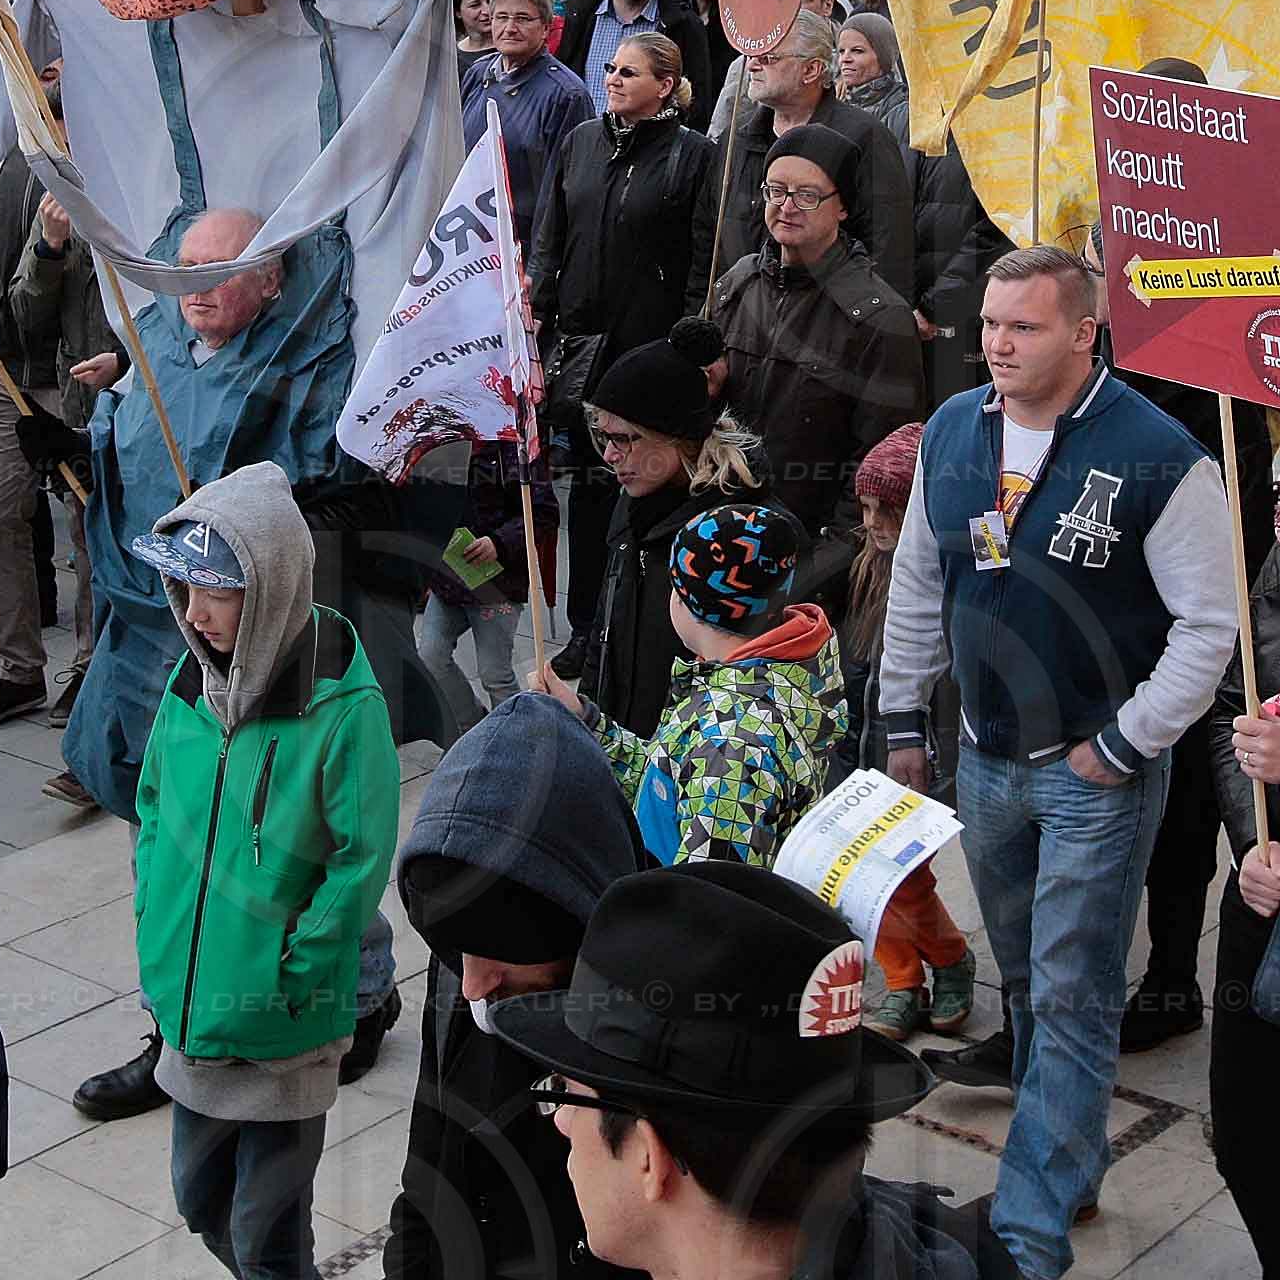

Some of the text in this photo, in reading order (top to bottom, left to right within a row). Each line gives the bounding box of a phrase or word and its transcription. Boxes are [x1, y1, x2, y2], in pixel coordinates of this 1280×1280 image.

[736, 33, 766, 51] anders
[766, 22, 782, 45] aus
[1101, 79, 1250, 145] Sozialstaat
[1105, 138, 1186, 190] kaputt
[1111, 203, 1222, 255] machen!
[1138, 269, 1184, 291] Keine
[1186, 268, 1222, 289] Lust
[882, 800, 914, 823] Ich
[840, 823, 887, 866] kaufe
[828, 981, 862, 1014] TTI
